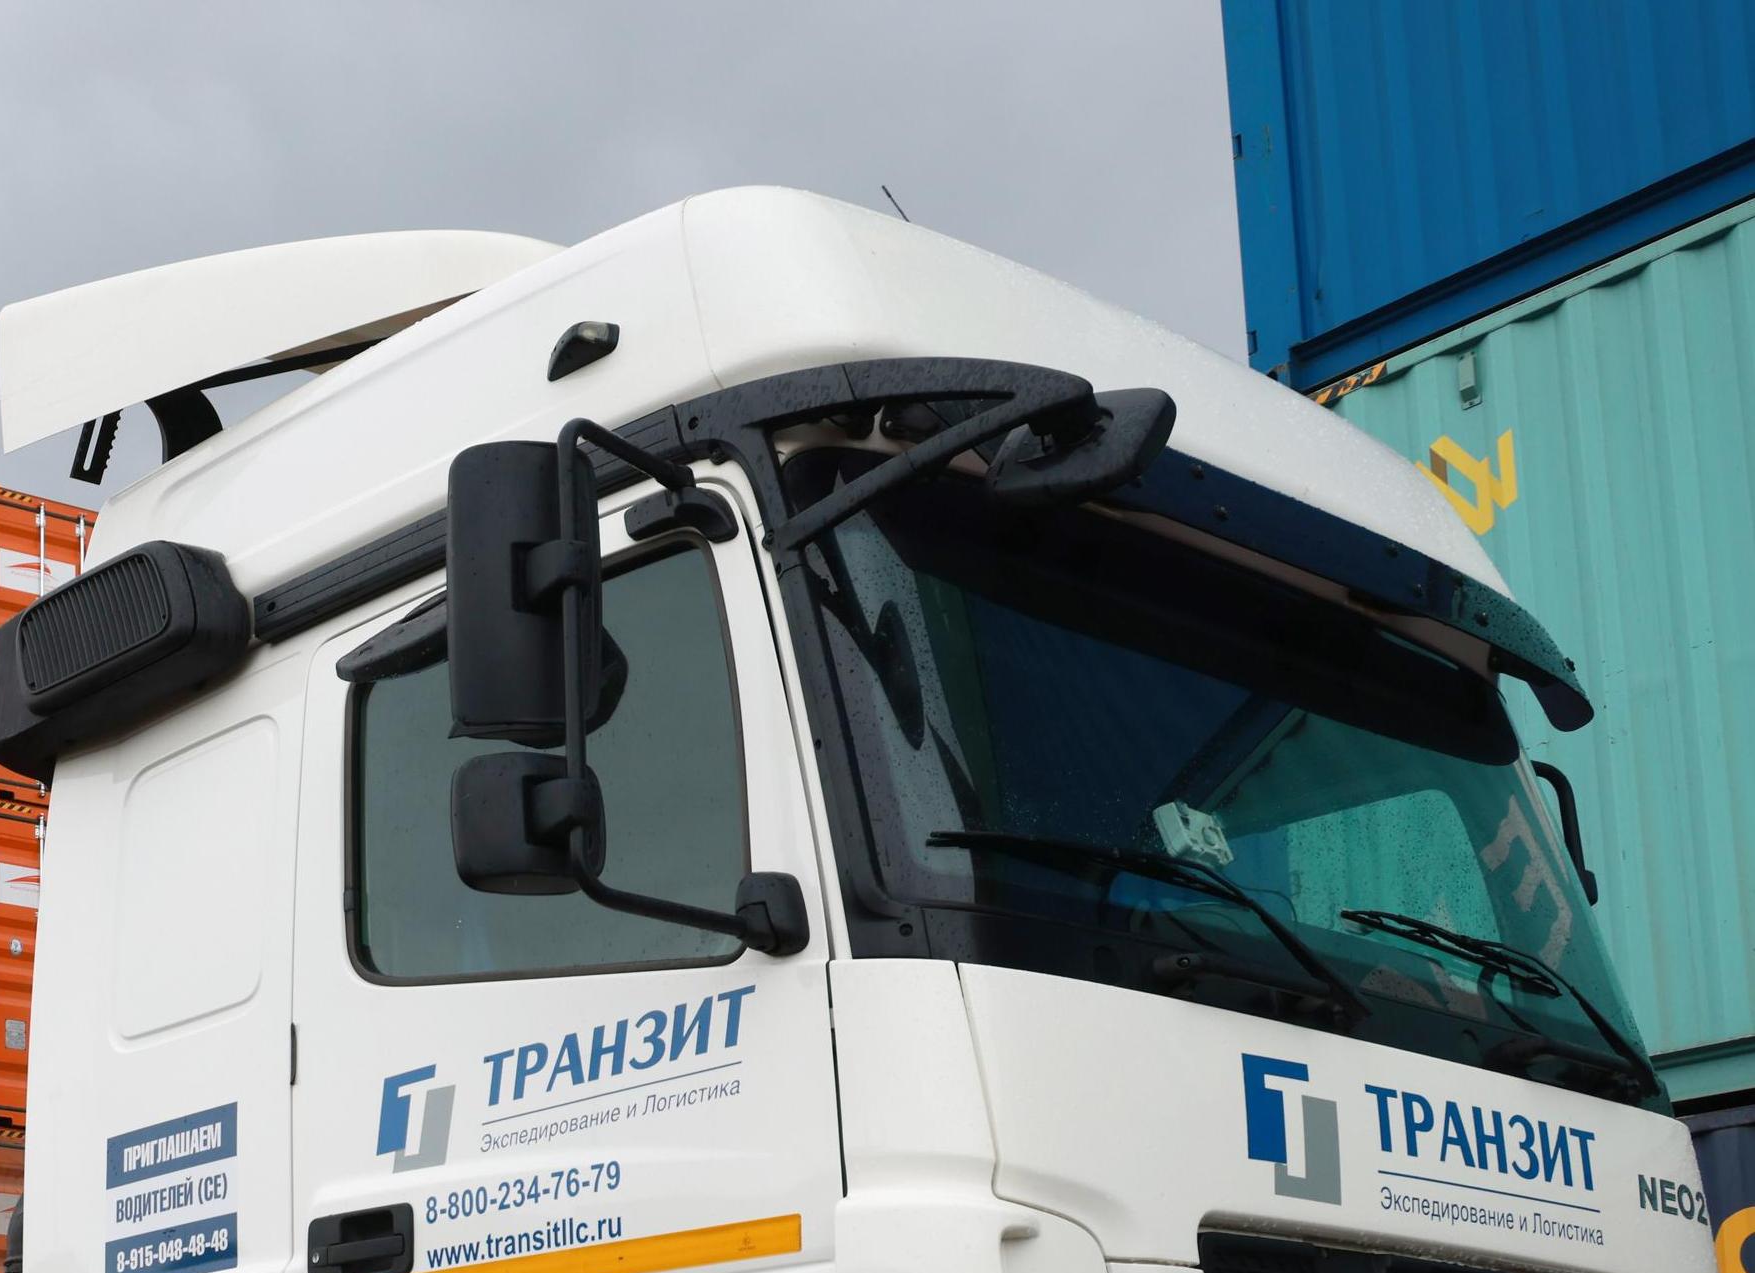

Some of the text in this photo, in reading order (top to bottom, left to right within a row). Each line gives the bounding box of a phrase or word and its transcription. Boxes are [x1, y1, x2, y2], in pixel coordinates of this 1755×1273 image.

[483, 984, 756, 1106] ТРАНЗИТ
[480, 1077, 741, 1153] Экспедирование и Логистика
[1365, 1083, 1595, 1191] ТРАНЗИТ
[123, 1122, 221, 1173] ПРИГЛАШАЕМ
[116, 1177, 193, 1223] ВОДИТЕЛЕЙ
[426, 1161, 621, 1224] 8-800-234-76-79
[1380, 1186, 1604, 1246] Экспедирование и Логистика
[1638, 1174, 1708, 1225] NEO2
[116, 1228, 228, 1273] 8-915-048-48-48
[427, 1217, 623, 1269] www.transitllc.ru
